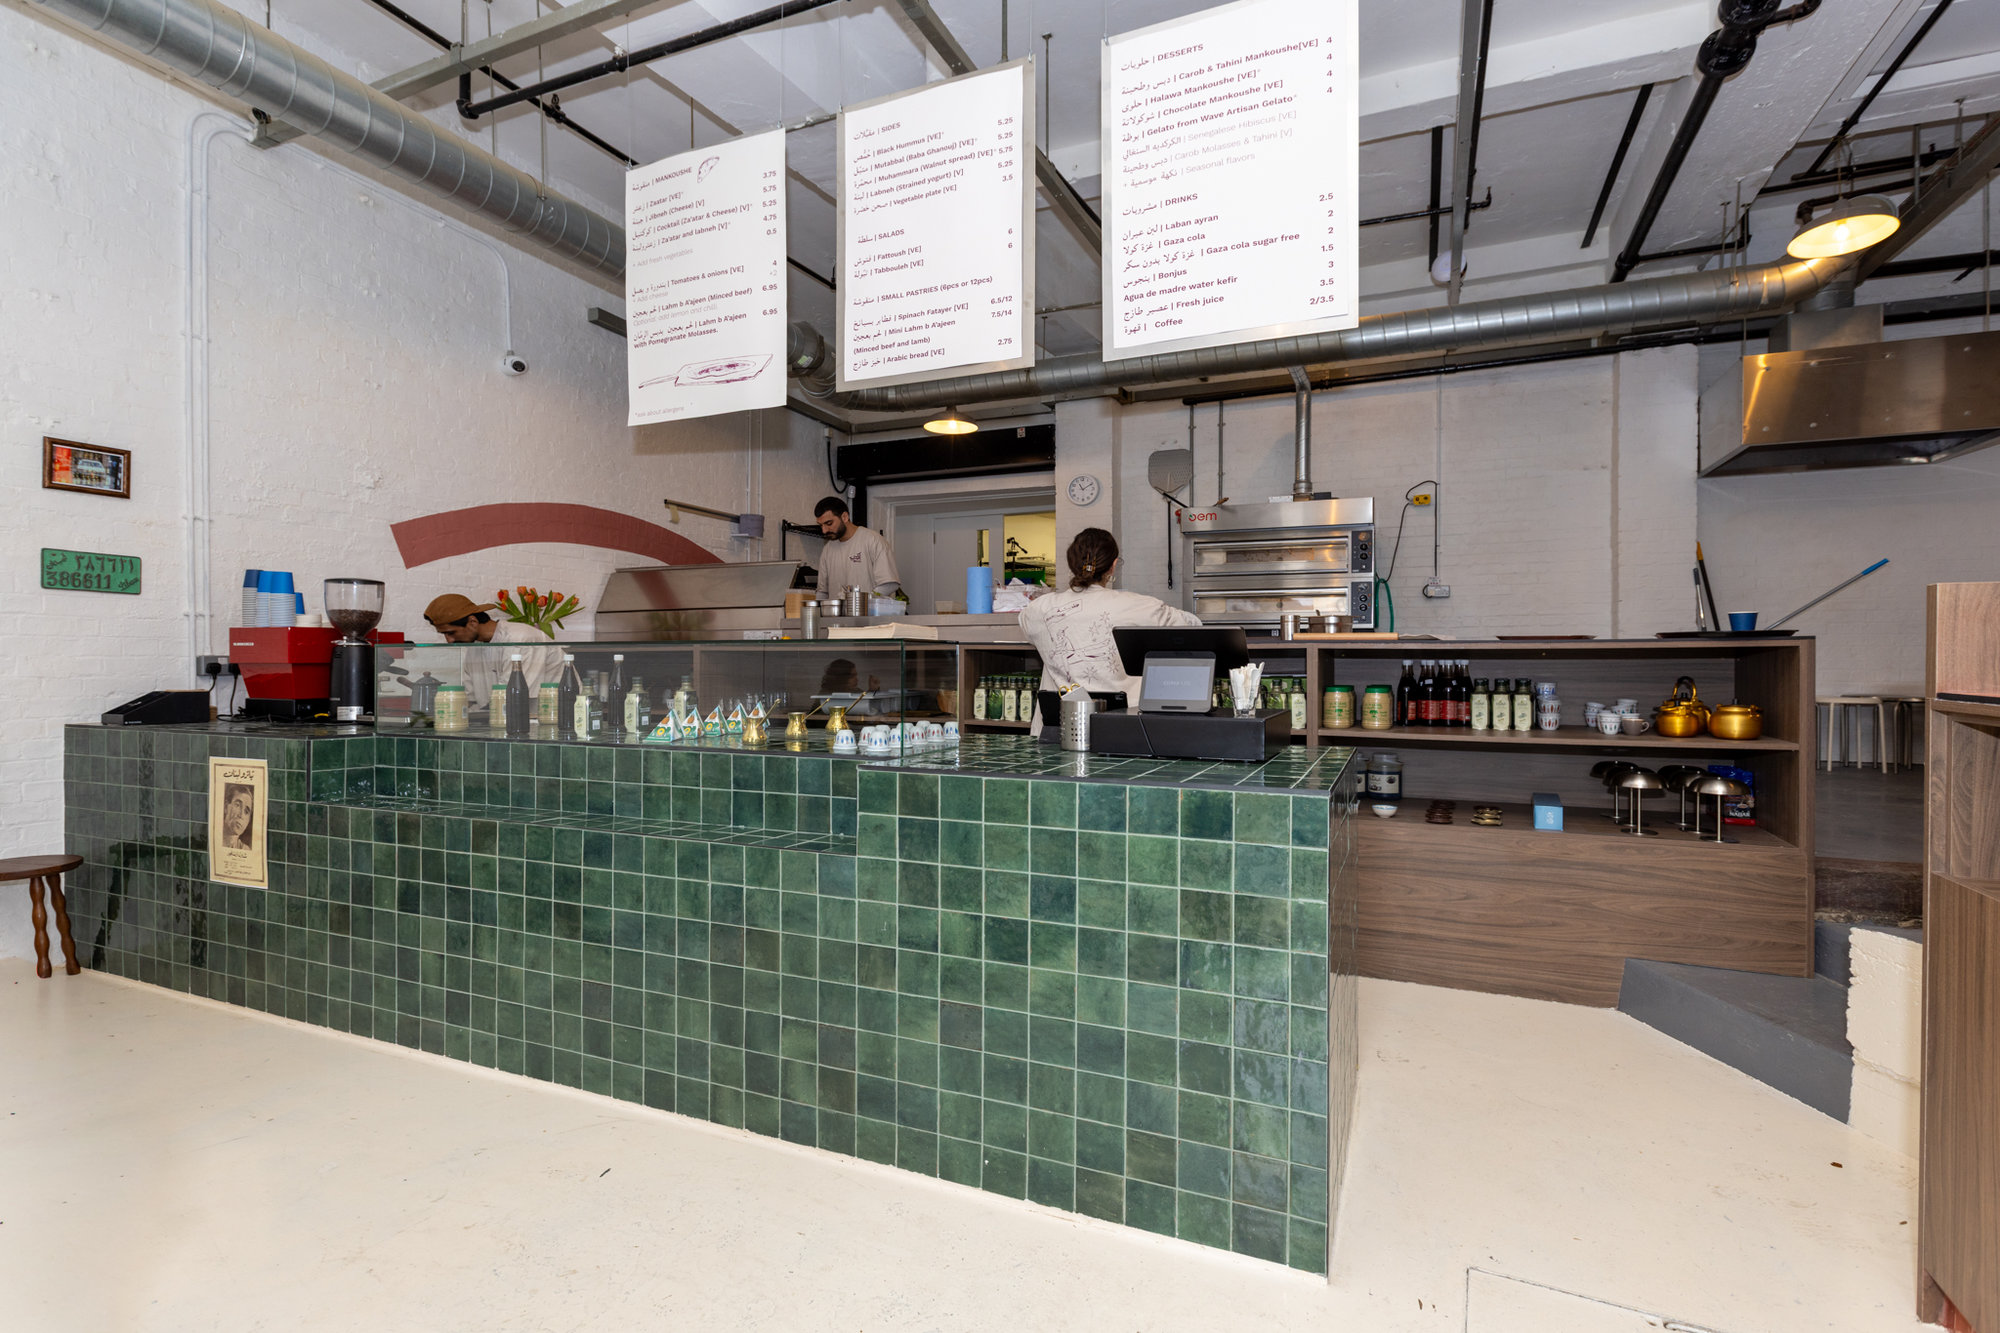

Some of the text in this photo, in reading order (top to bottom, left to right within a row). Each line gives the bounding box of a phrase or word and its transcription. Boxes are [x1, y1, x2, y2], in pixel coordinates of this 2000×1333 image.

[1157, 43, 1204, 61] DESSERTS
[1120, 57, 1149, 71] حلويات
[1178, 67, 1205, 80] Carob
[1215, 56, 1242, 70] Tahini
[1326, 69, 1333, 77] 4
[1150, 76, 1235, 104] Halawa Mankoushe
[1162, 79, 1283, 116] Chocolate Mankoushe [VE]
[997, 116, 1013, 126] 5.25
[1146, 103, 1259, 136] Gelato from Wave Artisan
[1187, 110, 1297, 141] Senegalese Hibiscus [VE]
[881, 121, 901, 133] SIDES
[997, 130, 1013, 140] 5.25
[876, 137, 925, 156] Black Hummus
[998, 144, 1013, 154] 5.75
[1174, 127, 1292, 160] Carob Molasses Tahini [V]
[874, 141, 957, 170] Mutabbal (Baba Ghanouj)
[878, 151, 976, 182] Muhammara (Walnut spread)
[997, 159, 1013, 169] 5.25
[1185, 153, 1255, 173] Seasonal flavors
[762, 169, 777, 179] 3.75
[1002, 173, 1013, 182] 3.5
[762, 184, 777, 193] 5.75
[869, 168, 964, 197] Labneh (Strained yogurt) [V]
[892, 183, 957, 205] Vegetable plate [VE]
[1165, 192, 1198, 206] DRINKS
[1319, 192, 1334, 202] 2.5
[649, 197, 668, 207] Zaatar
[668, 201, 694, 215] (Cheese)
[695, 198, 705, 209] [V]
[762, 198, 777, 208] 5.25
[711, 205, 738, 217] Cheese)
[1122, 203, 1157, 216] مشروبات
[1327, 209, 1334, 217] 2
[762, 213, 777, 222] 4.75
[1165, 215, 1219, 230] Laban ayran
[681, 224, 717, 238] and labneh
[766, 227, 777, 236] 0.5
[878, 228, 905, 240] SALADS
[1007, 227, 1013, 235] 6
[1122, 230, 1144, 241] عيران
[1327, 226, 1334, 234] 2
[1163, 232, 1206, 246] Gaza cola
[1206, 233, 1300, 255] Gaza cola sugar free
[877, 244, 922, 260] Fattoush [VE]
[1320, 243, 1334, 252] 1.5
[873, 258, 924, 274] Tabbouleh [VE]
[1328, 260, 1334, 268] 3
[670, 264, 744, 285] Tomatoes onions [VE]
[1158, 269, 1187, 280] Bonjus
[761, 283, 778, 292] 6.95
[1319, 277, 1334, 287] 3.5
[880, 292, 904, 302] SMALL
[905, 285, 939, 297] PASTRIES
[939, 282, 959, 292] (6pcs
[970, 275, 993, 286] 12pcs)
[1123, 275, 1238, 302] Agua de madre water kefir
[661, 287, 753, 311] Lahm (Minced beef)
[990, 295, 1013, 305] 6.5/12
[1176, 295, 1224, 309] Fresh juice
[1309, 294, 1334, 305] 2/3.5
[762, 307, 778, 316] 6.95
[897, 302, 969, 321] Spinach Fatayer [VE]
[991, 309, 1012, 318] 7.5/14
[698, 318, 717, 327] Lahm
[1154, 318, 1183, 328] Coffee
[888, 327, 903, 335] Mini
[904, 324, 924, 333] Lahm
[1124, 323, 1141, 335] قهوة
[633, 340, 647, 349] with
[647, 333, 687, 345] Pomegranate
[853, 336, 931, 355] (Minced beef and lamb)
[997, 337, 1013, 346] 2.75
[886, 347, 945, 363] Arabic bread [VE]
[46, 571, 111, 589] 386611
